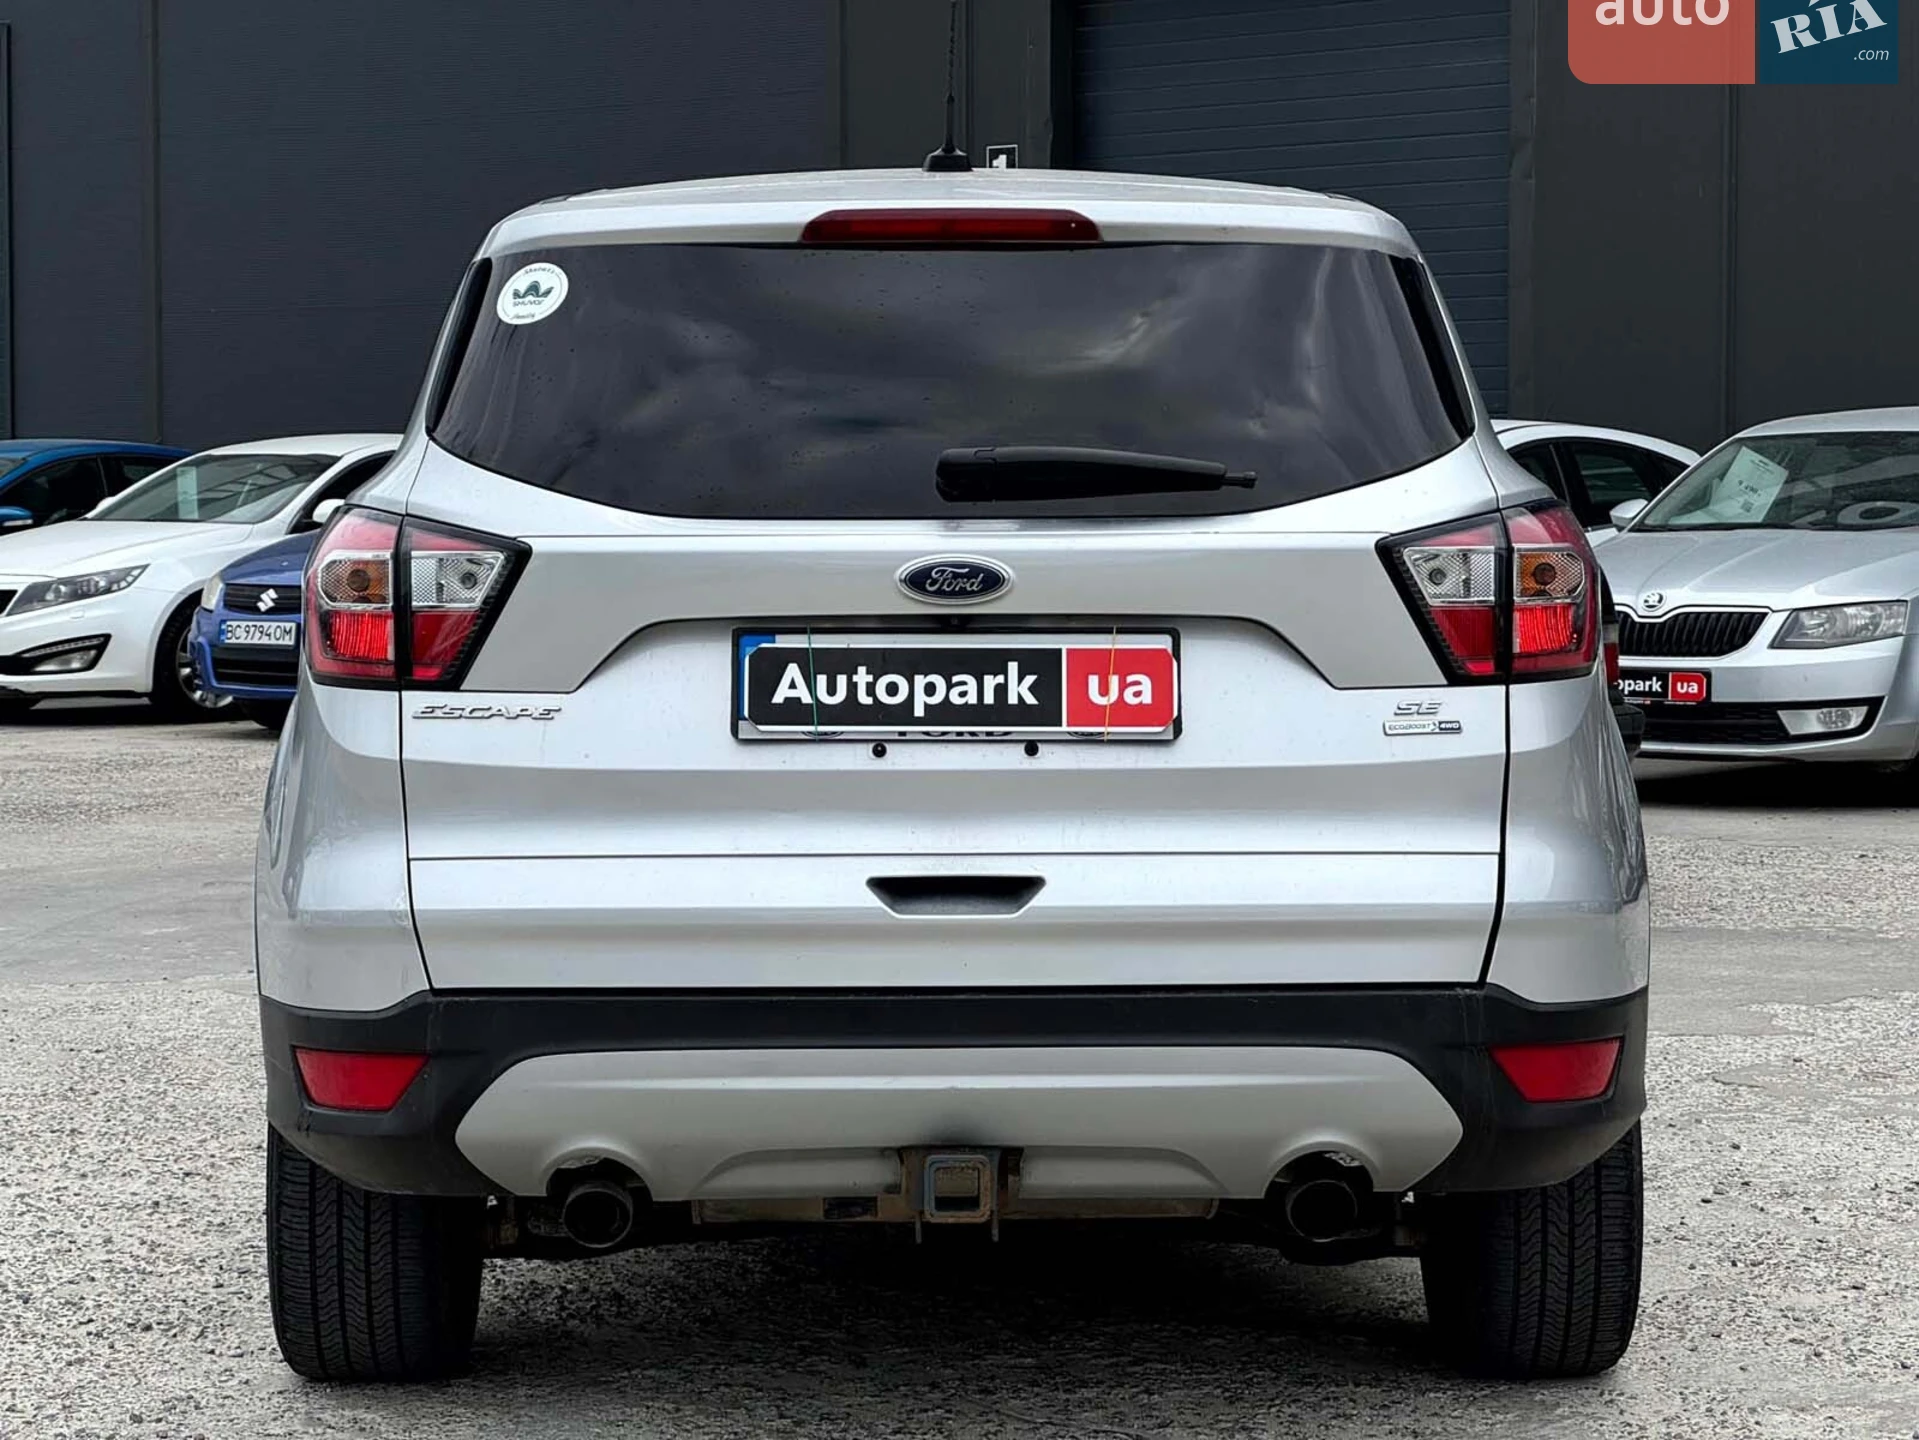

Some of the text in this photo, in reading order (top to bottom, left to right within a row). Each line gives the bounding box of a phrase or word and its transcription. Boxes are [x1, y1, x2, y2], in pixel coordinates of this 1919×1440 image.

[925, 566, 985, 592] Ford
[244, 624, 271, 641] 9794
[771, 662, 1153, 717] Autopark ua
[1676, 681, 1699, 693] ua
[412, 704, 562, 720] ESCAPE
[1393, 700, 1443, 716] SE
